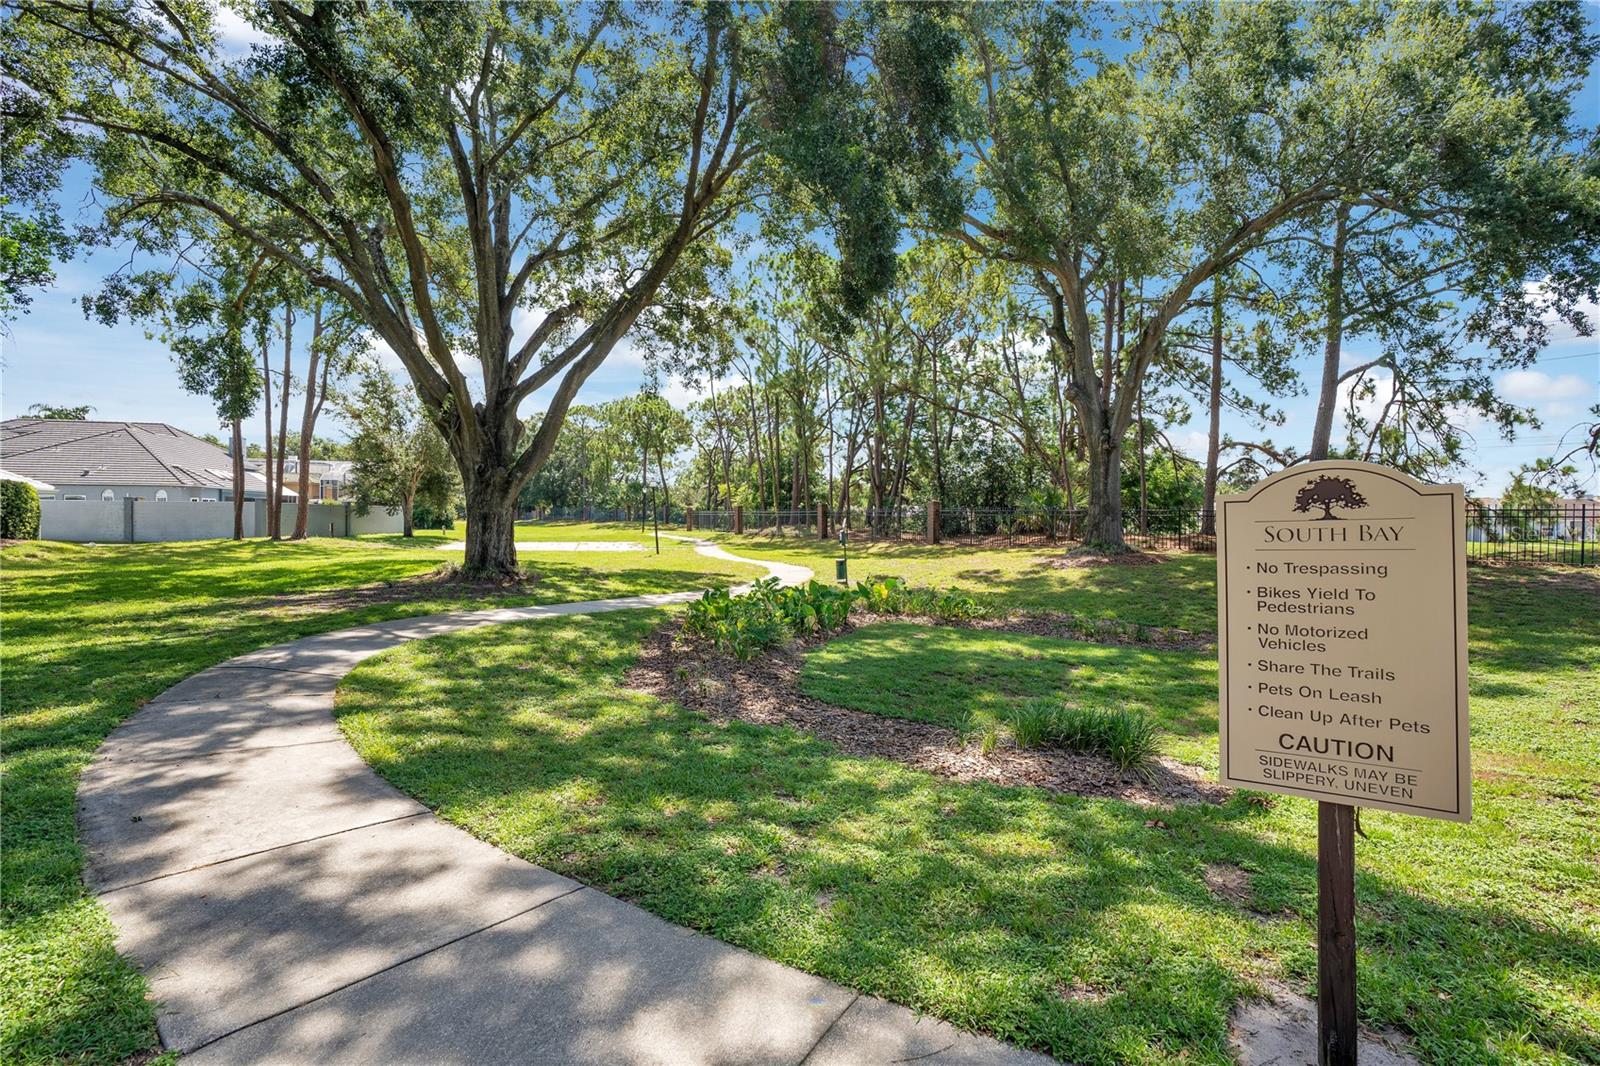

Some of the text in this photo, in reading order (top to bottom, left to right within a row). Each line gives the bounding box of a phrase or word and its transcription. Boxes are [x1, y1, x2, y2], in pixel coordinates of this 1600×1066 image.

[1256, 562, 1388, 578] No Trespassing
[1257, 586, 1376, 600] Bikes Yield To
[1257, 601, 1355, 615] Pedestrians
[1257, 623, 1368, 640] No Motorized
[1258, 638, 1327, 653] Vehicles
[1257, 660, 1395, 681] Share The Trails
[1258, 682, 1382, 704] Pets On Leash
[1258, 705, 1431, 734] Clean Up After Pets
[1279, 733, 1394, 762] CAUTION
[1259, 755, 1417, 786] SIDEWALKS MAY BE
[1344, 779, 1413, 799] UNEVEN
